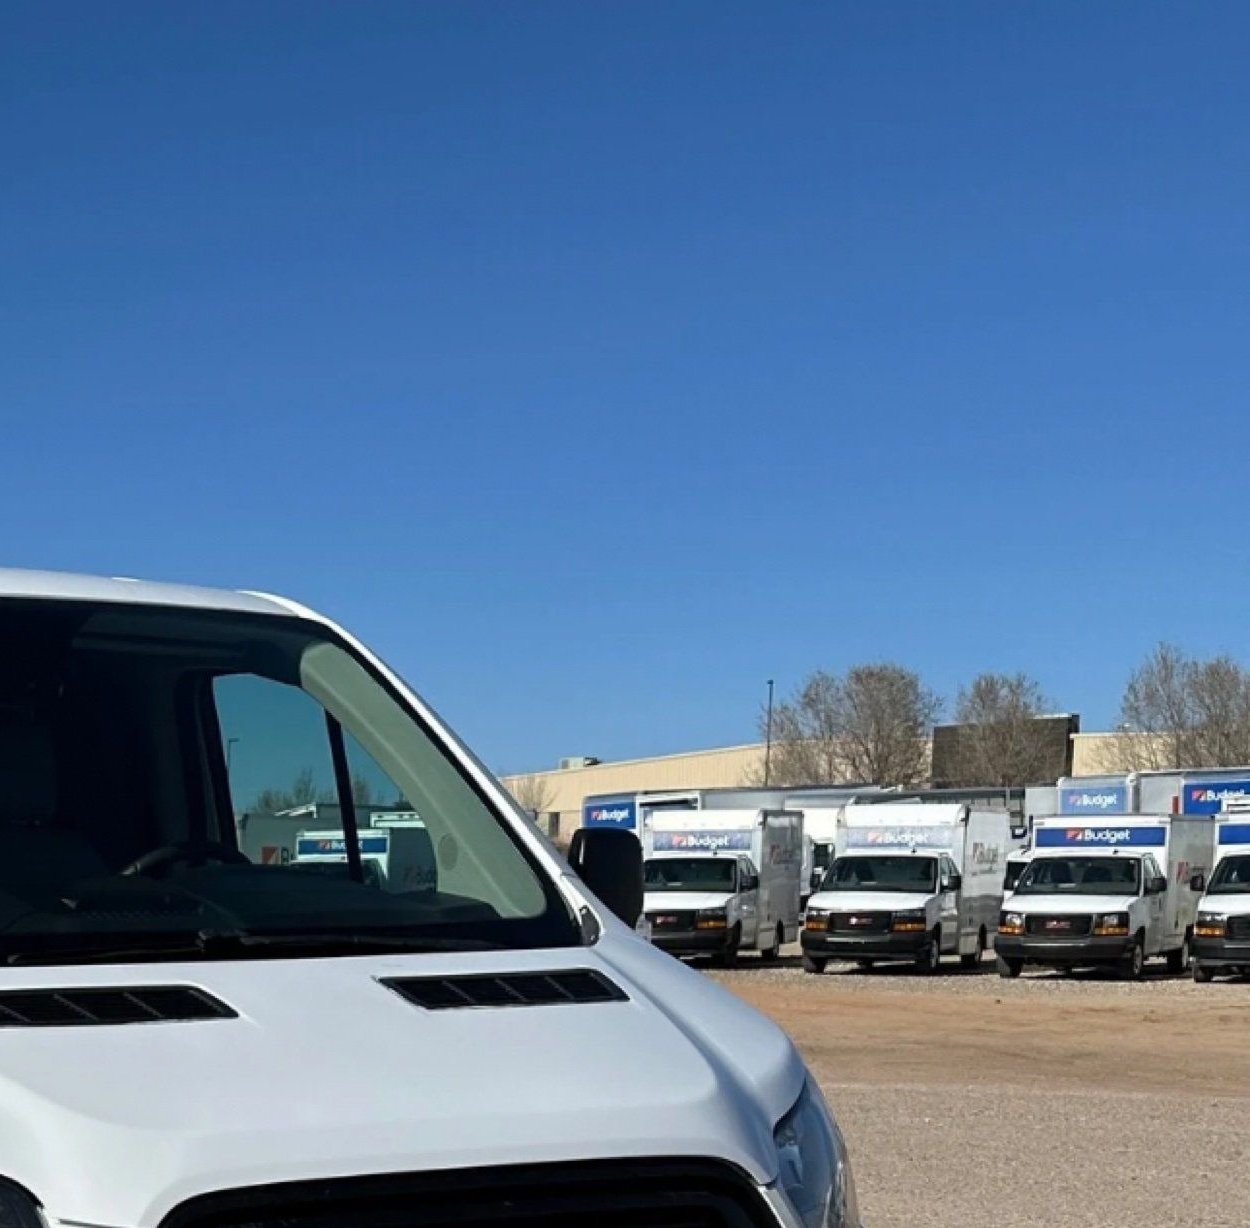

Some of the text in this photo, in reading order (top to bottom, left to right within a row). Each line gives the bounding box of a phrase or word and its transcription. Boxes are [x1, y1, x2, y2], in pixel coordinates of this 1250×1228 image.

[1082, 793, 1117, 808] Budget
[601, 808, 629, 822] Budget
[687, 834, 729, 850] Budget
[1084, 828, 1131, 844] Budget
